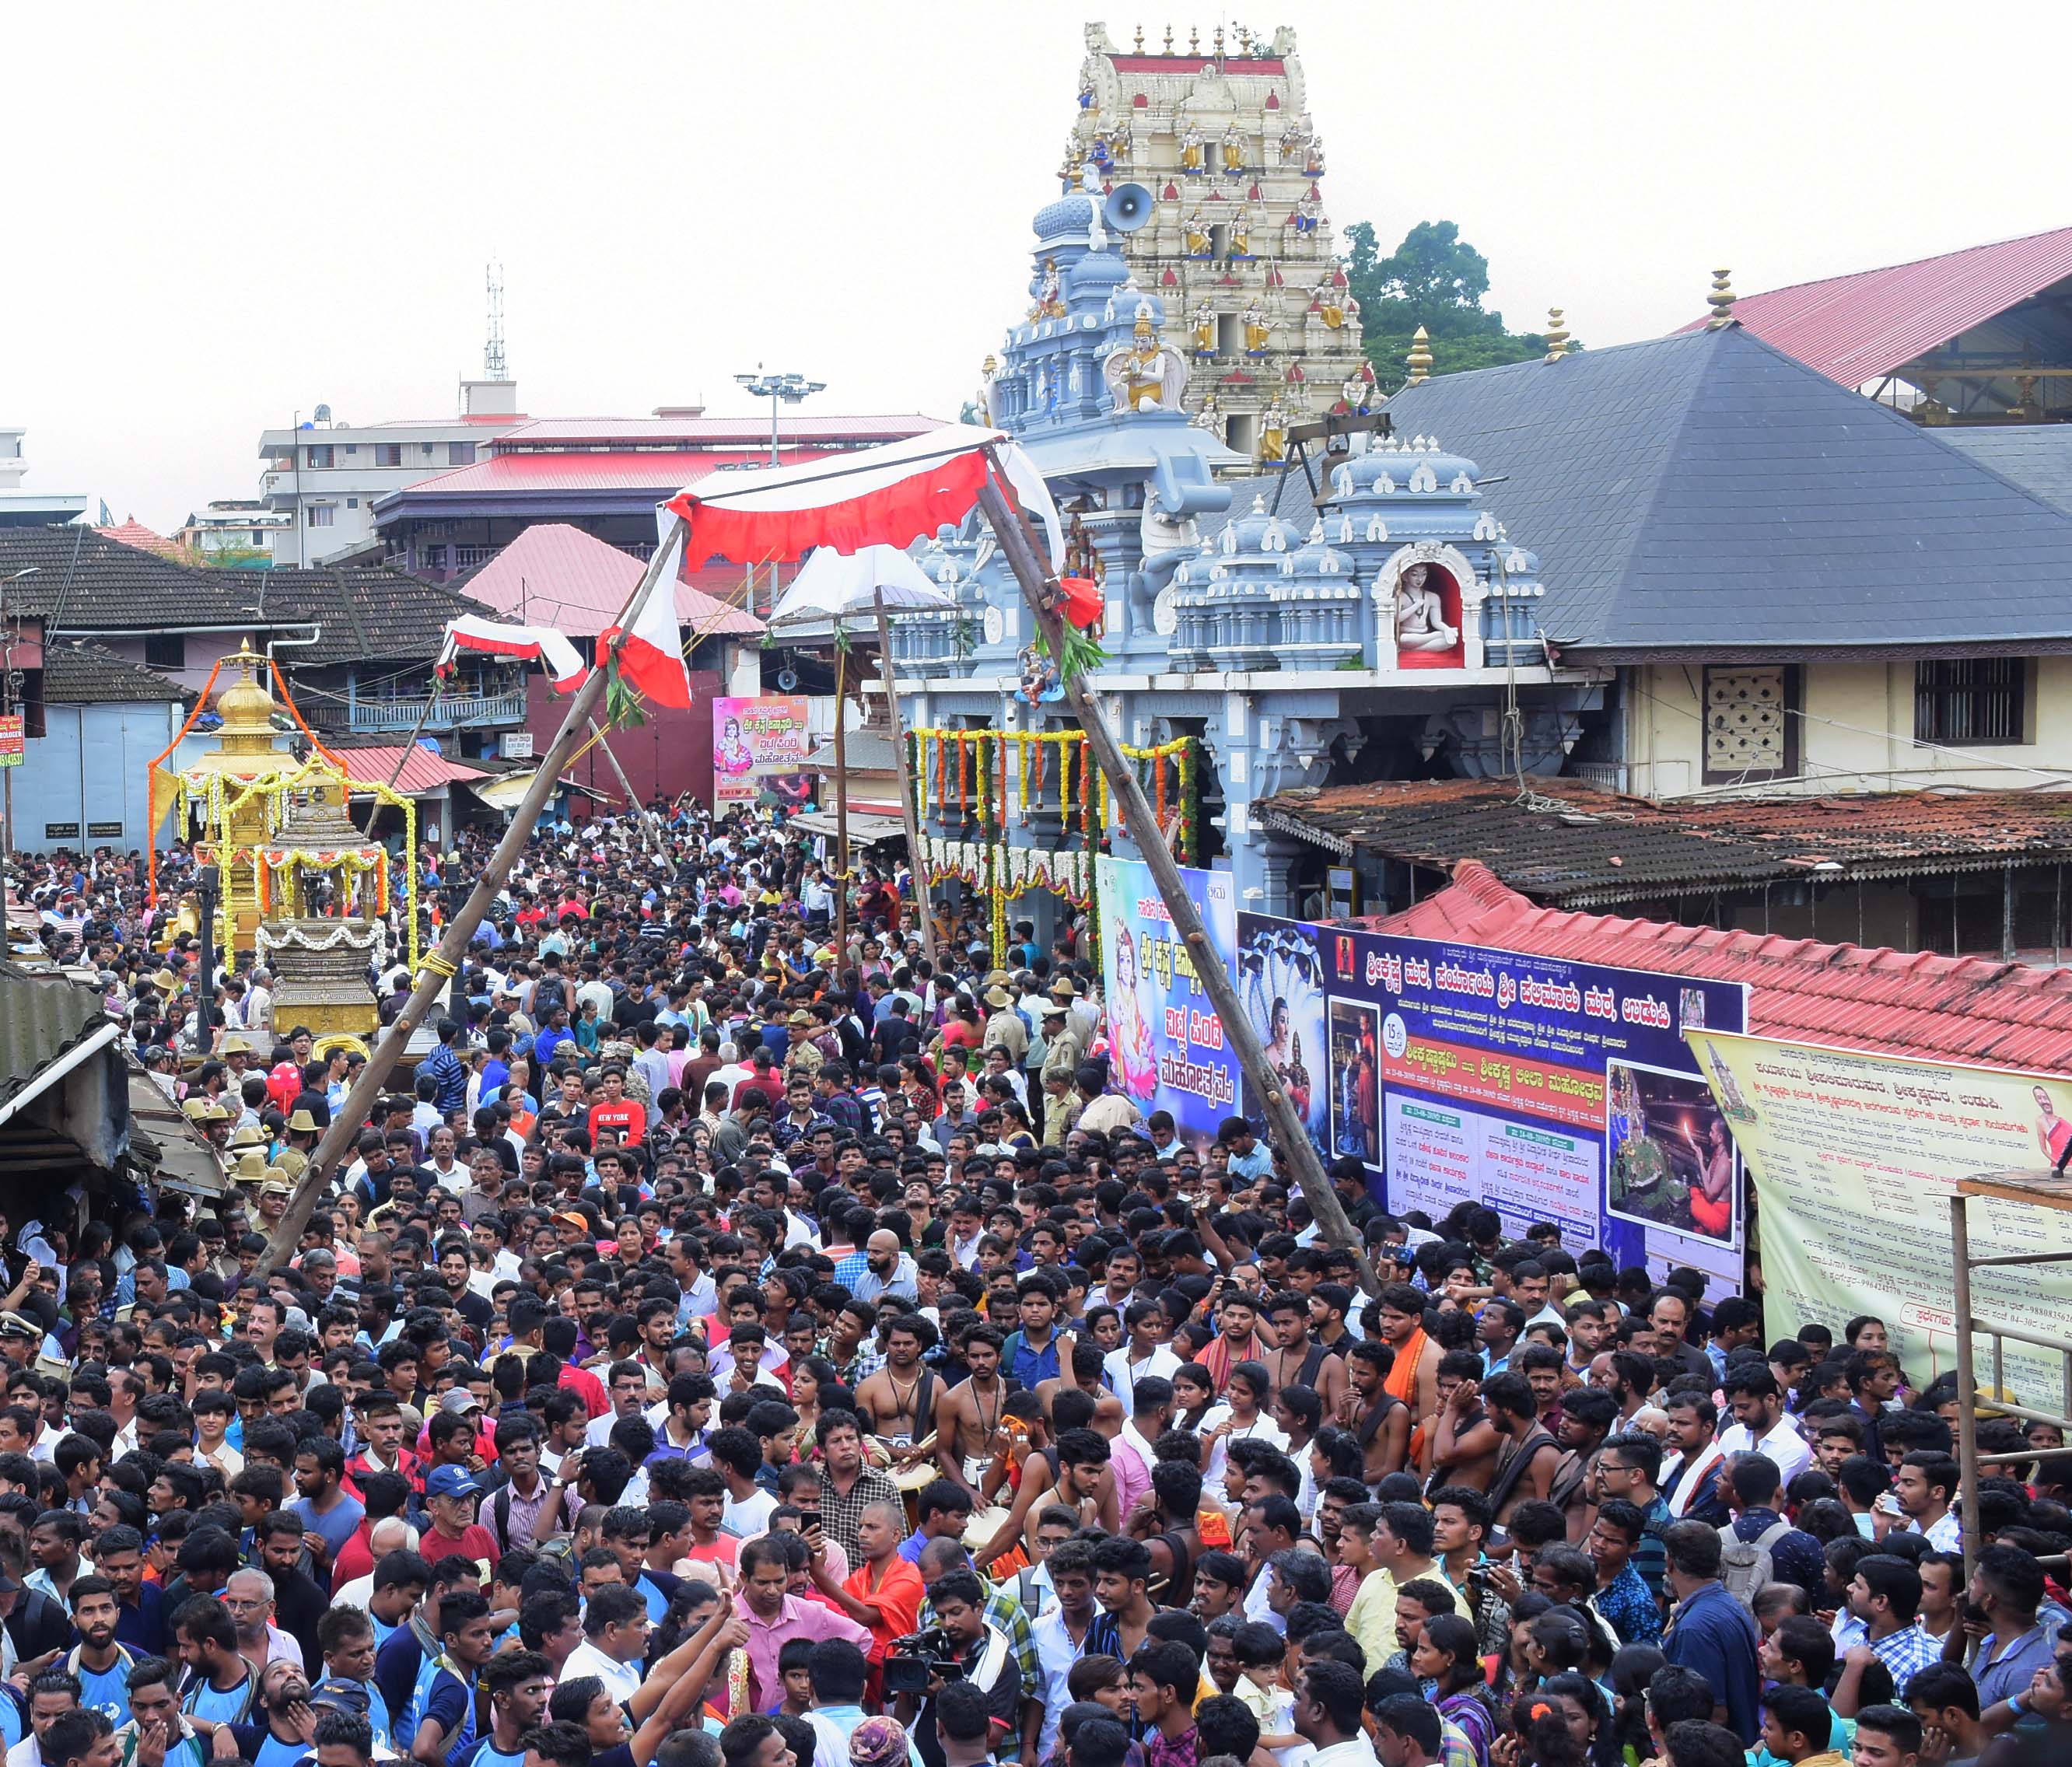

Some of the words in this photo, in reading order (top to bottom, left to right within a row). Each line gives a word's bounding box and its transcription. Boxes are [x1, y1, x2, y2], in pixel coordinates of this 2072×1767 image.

[1139, 931, 1153, 980] ಶ್ರೀ
[1154, 936, 1172, 992] ಕೃಷ್ಣ
[1366, 951, 1402, 995] ಶ್ರೀಕೃಷ್ಣ
[1405, 957, 1431, 990] ಮಠ,
[1435, 961, 1494, 998] ಪರ್ಯಾಯ
[1497, 971, 1516, 1009] ಶ್ರೀ
[1520, 974, 1580, 1013] ಪಲಿಮಾರು
[1584, 985, 1617, 1023] ಮಠ,
[1622, 994, 1671, 1029] ಉಡುಪಿ
[1387, 1023, 1395, 1039] 15
[1479, 1056, 1511, 1090] ಶ್ರೀಕೃಷ್ಣ
[1516, 1068, 1544, 1087] ಲೀಲಾ
[1548, 1072, 1603, 1107] ಮಹೋತ್ಸವ
[1755, 1062, 1802, 1079] ಪರ್ಯಾಯ
[611, 1113, 629, 1121] YORK
